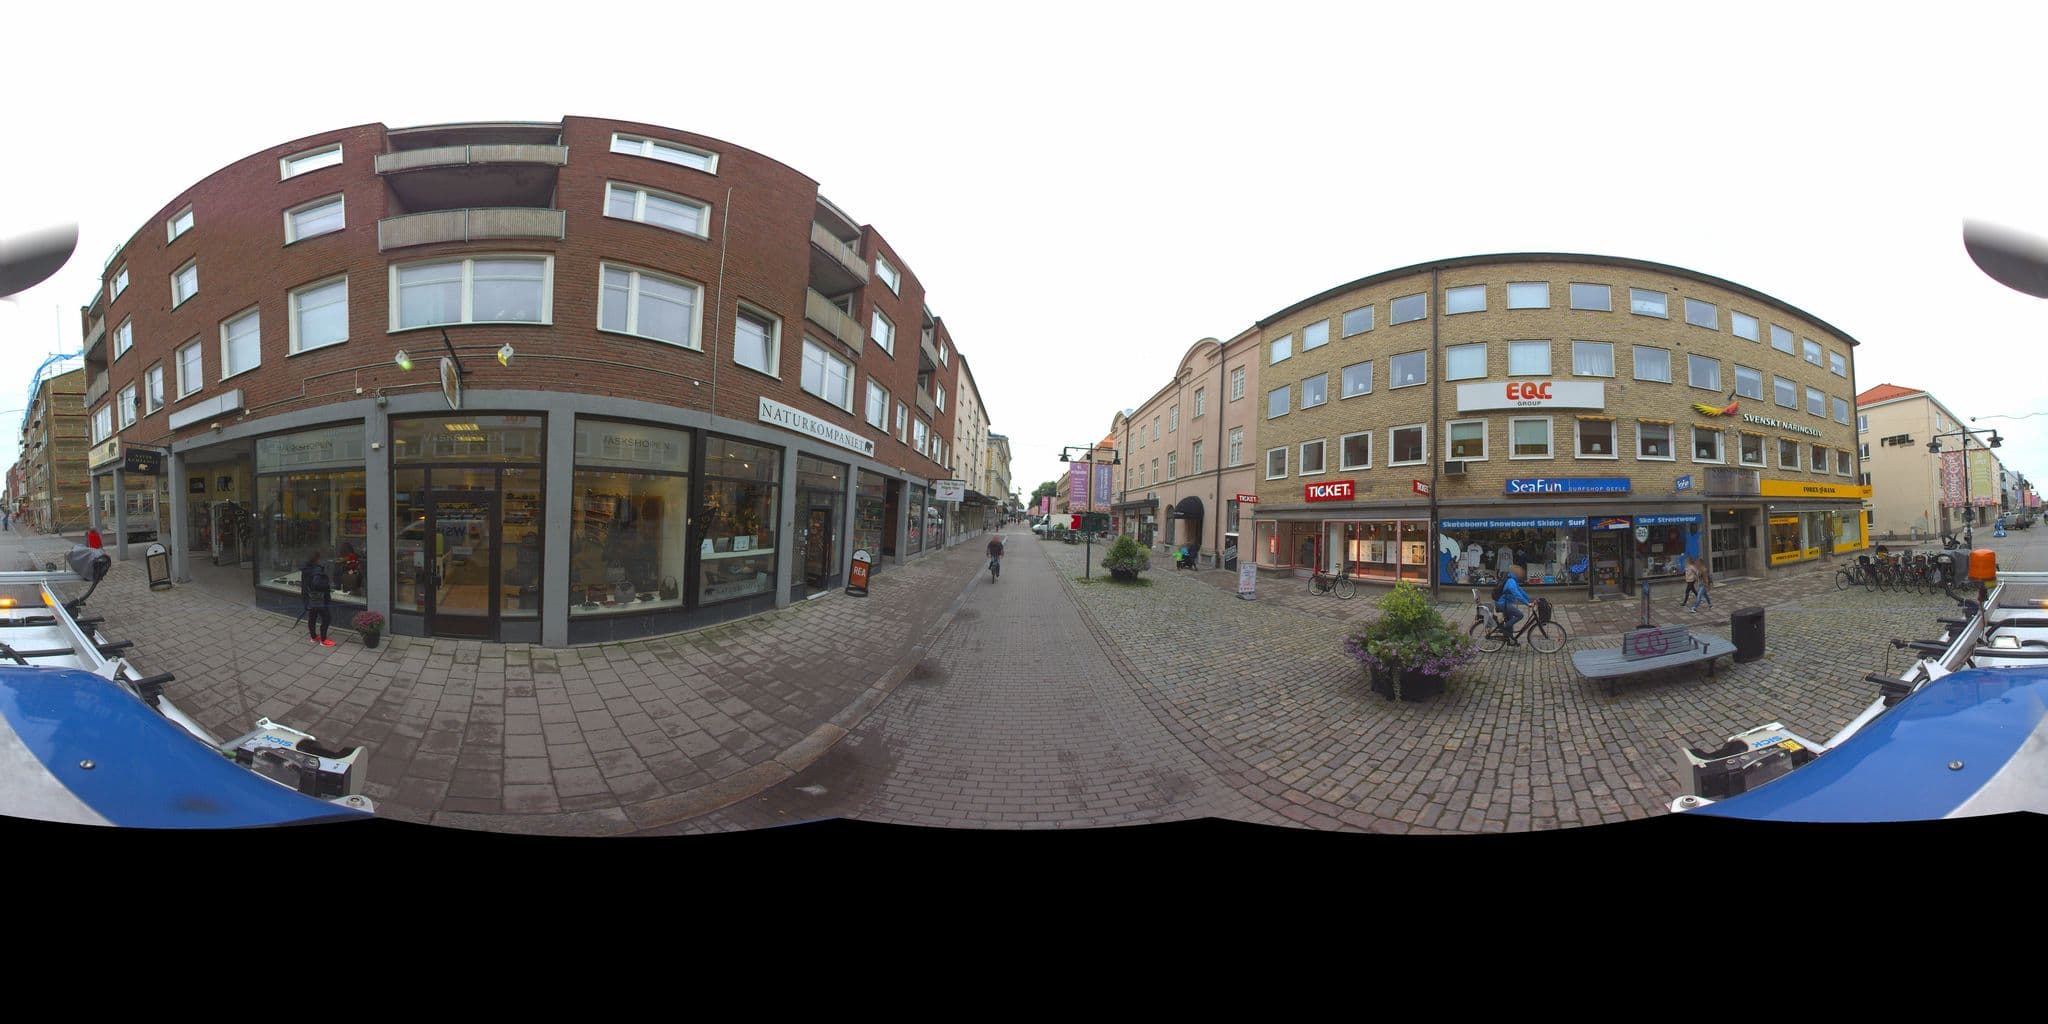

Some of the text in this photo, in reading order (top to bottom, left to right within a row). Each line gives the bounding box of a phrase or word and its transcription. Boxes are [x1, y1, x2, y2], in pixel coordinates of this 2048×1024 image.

[1506, 382, 1553, 400] EQC
[762, 403, 865, 450] NATURKOMPANIET
[1743, 413, 1781, 428] SVENSKT
[1308, 483, 1350, 498] TICKET
[1511, 479, 1562, 493] SeaFun
[1442, 520, 1488, 528] Skateboard
[1489, 520, 1535, 528] Snowboard
[1537, 519, 1563, 527] Skidor
[1568, 519, 1585, 527] Surf
[1657, 516, 1697, 524] Streetwear
[853, 566, 866, 577] REA
[263, 734, 294, 748] SICK
[1751, 735, 1783, 748] SICK
